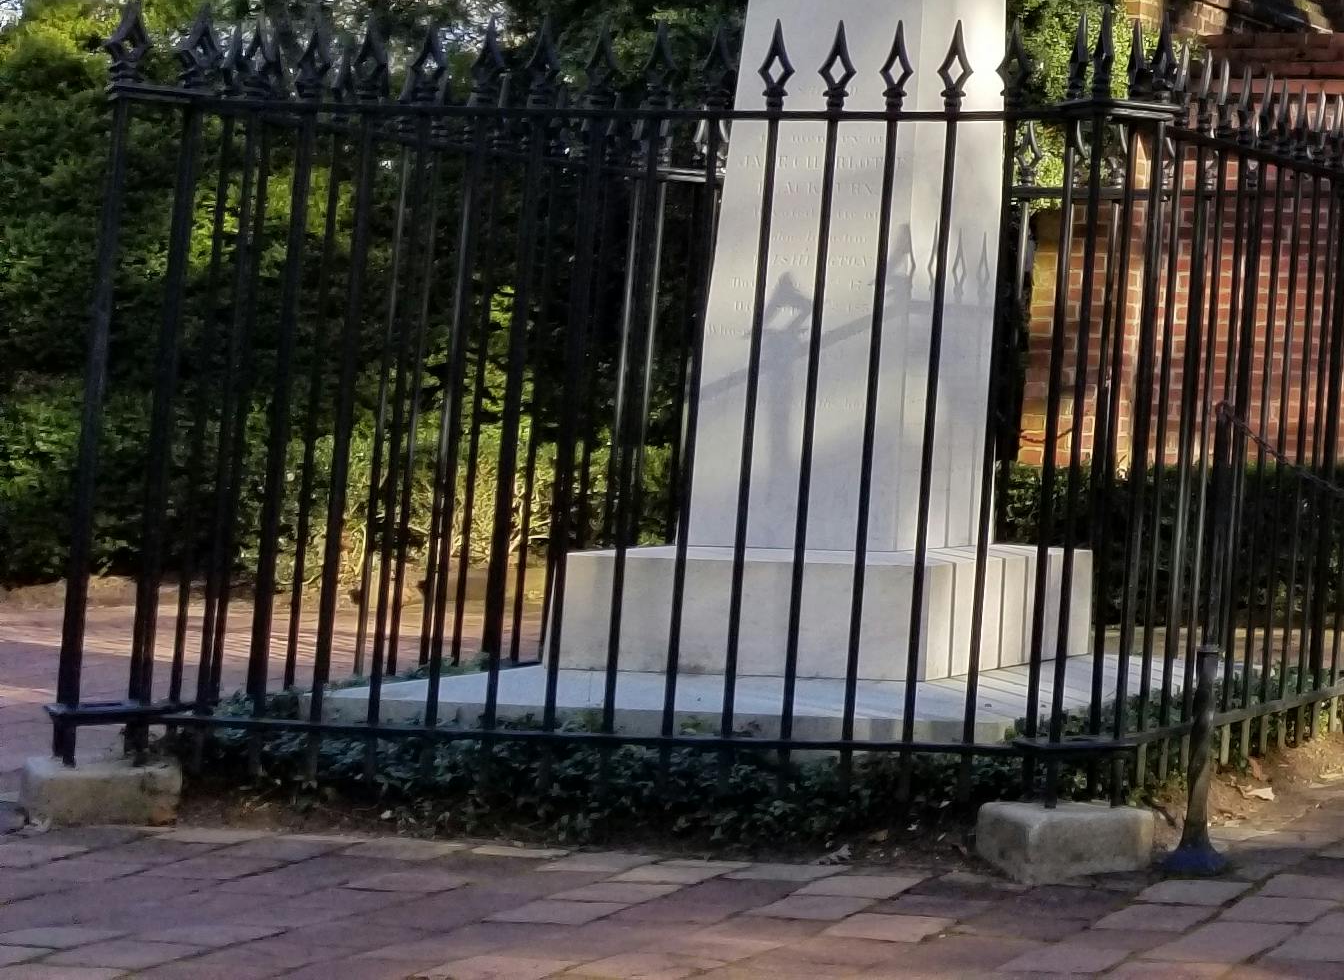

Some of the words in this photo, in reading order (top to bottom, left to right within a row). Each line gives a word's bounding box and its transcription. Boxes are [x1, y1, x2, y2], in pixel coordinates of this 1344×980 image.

[791, 134, 858, 147] memry
[738, 155, 787, 169] JAE
[793, 155, 906, 170] CHRLOTE
